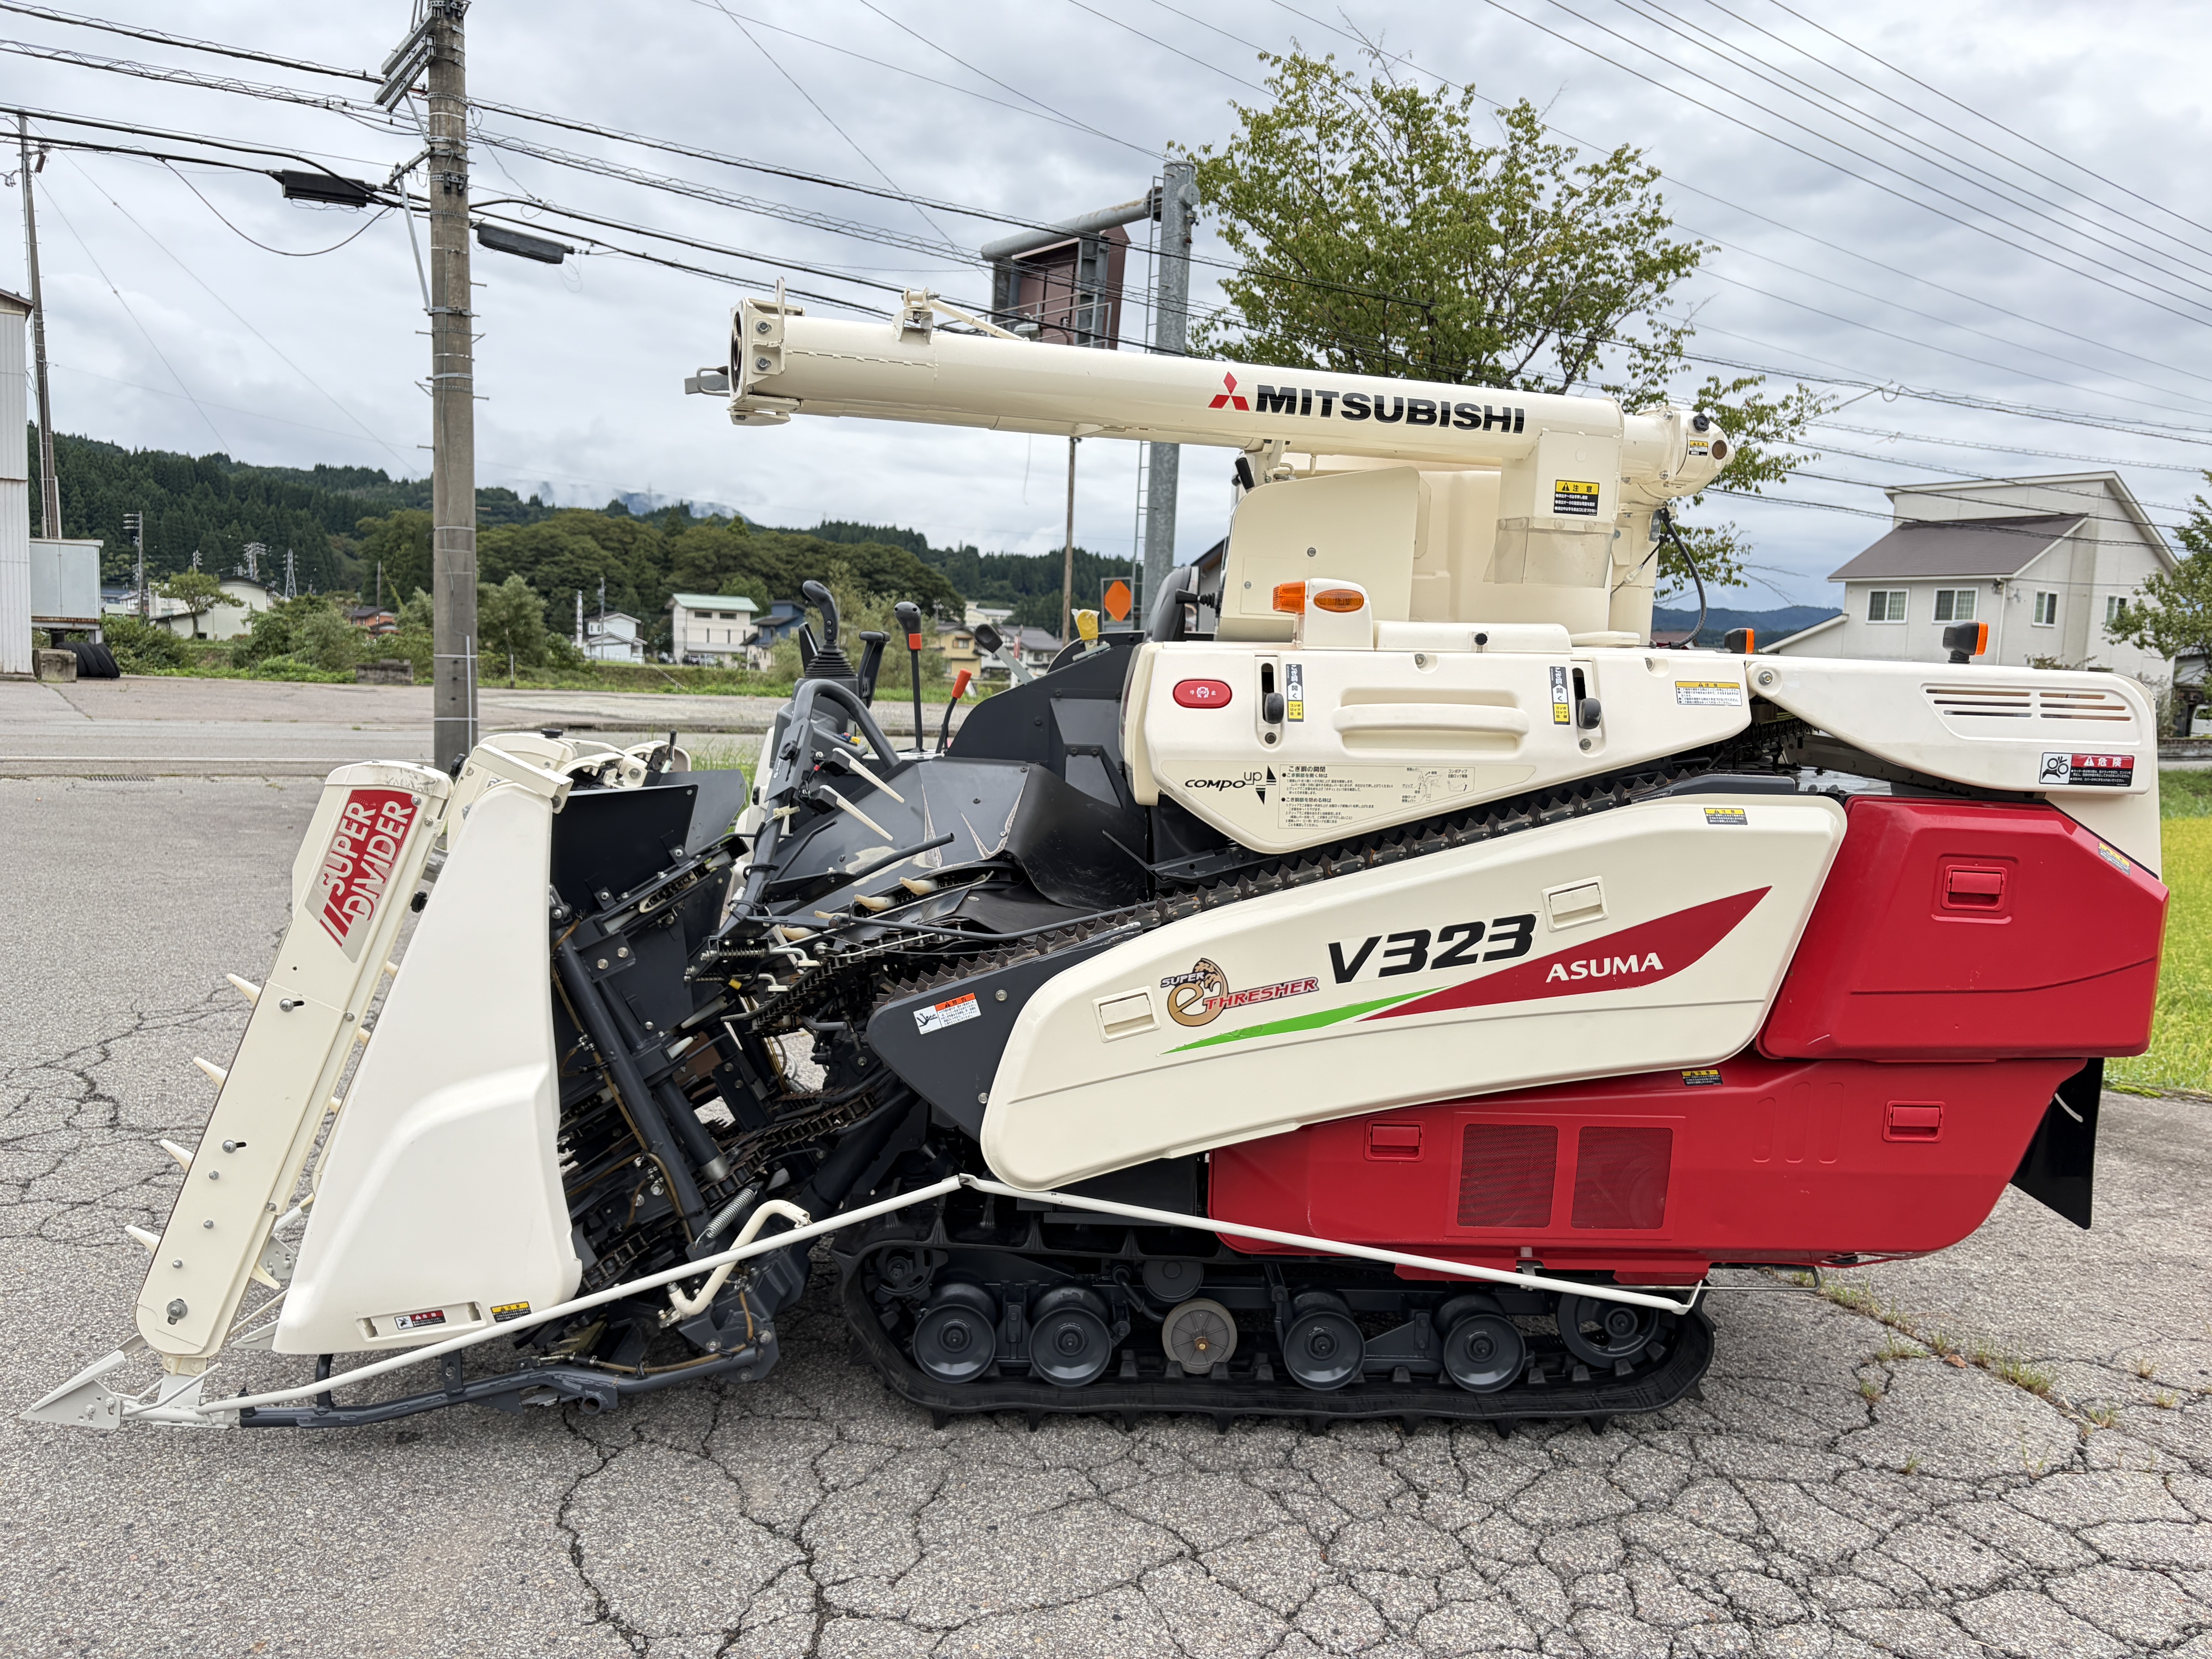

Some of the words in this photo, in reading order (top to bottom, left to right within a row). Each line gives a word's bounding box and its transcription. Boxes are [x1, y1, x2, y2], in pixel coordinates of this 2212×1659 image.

[1256, 385, 1525, 434] MITSUBISHI
[1573, 484, 1592, 493] 注意
[2098, 757, 2122, 767] 危険
[318, 802, 376, 896] SUPER
[342, 801, 413, 919] DIVIDER
[1328, 914, 1536, 984] V323
[1161, 972, 1205, 987] SUPER
[1546, 952, 1664, 983] ASUMA
[1205, 979, 1316, 1010] THRESHER
